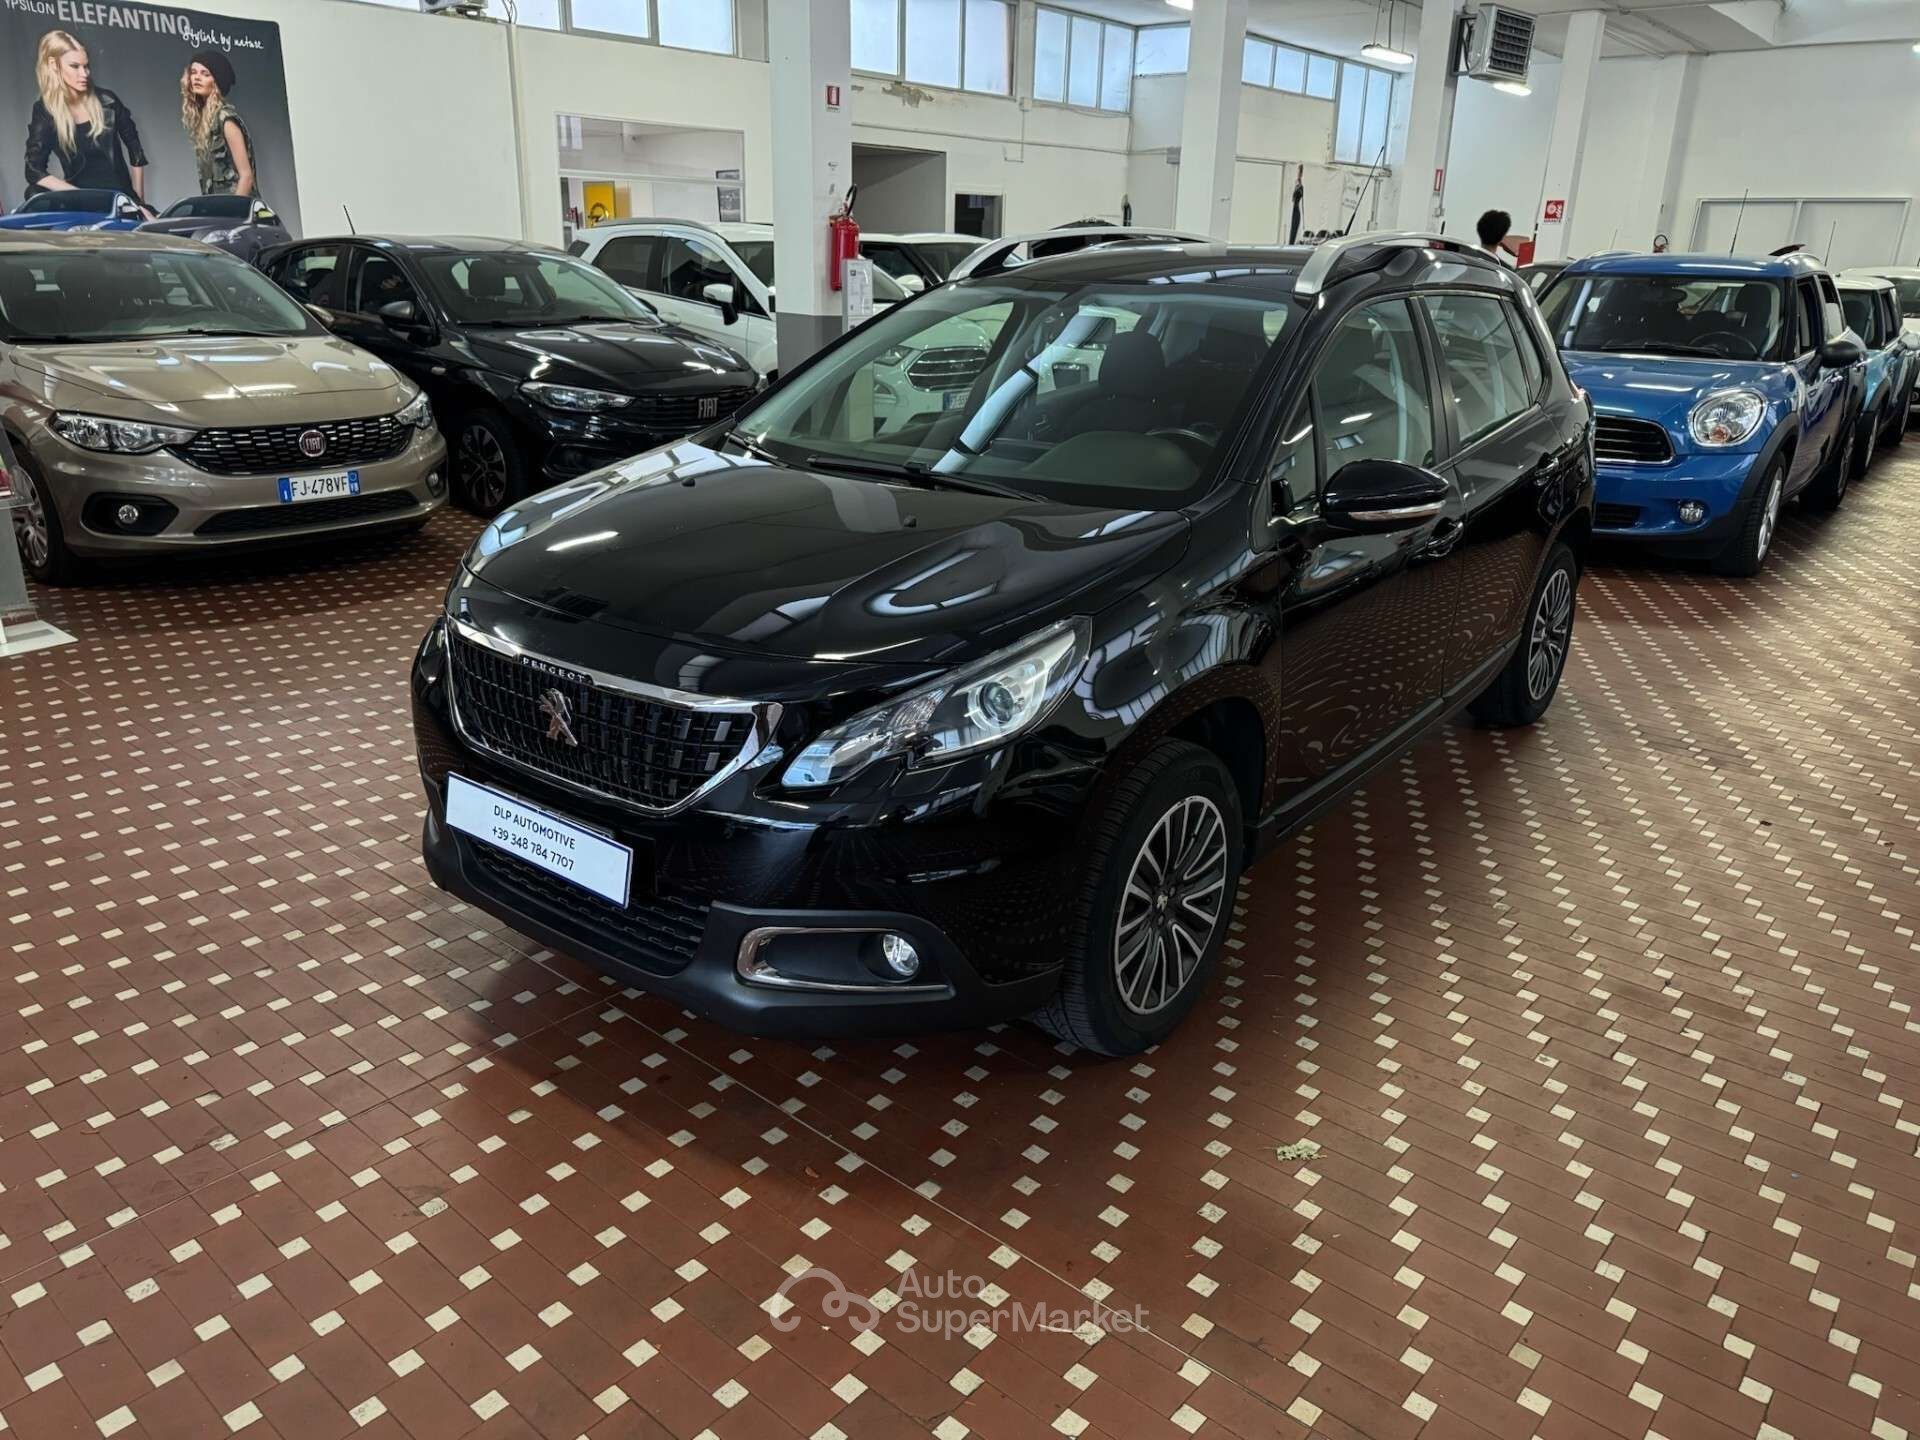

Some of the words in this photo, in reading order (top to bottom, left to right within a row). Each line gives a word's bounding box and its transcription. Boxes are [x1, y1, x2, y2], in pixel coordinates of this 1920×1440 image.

[5, 0, 55, 15] YPSILON
[57, 0, 190, 36] ELEFANTINO
[220, 33, 232, 52] by
[234, 38, 264, 49] nature
[698, 397, 719, 419] FIAT
[523, 657, 585, 682] PEUGEOT
[494, 805, 512, 823] DLP
[513, 813, 576, 850] AUTOMOTIVE
[492, 825, 509, 841] +39
[510, 833, 529, 850] 348
[530, 842, 548, 860] 784
[550, 851, 575, 871] 7707
